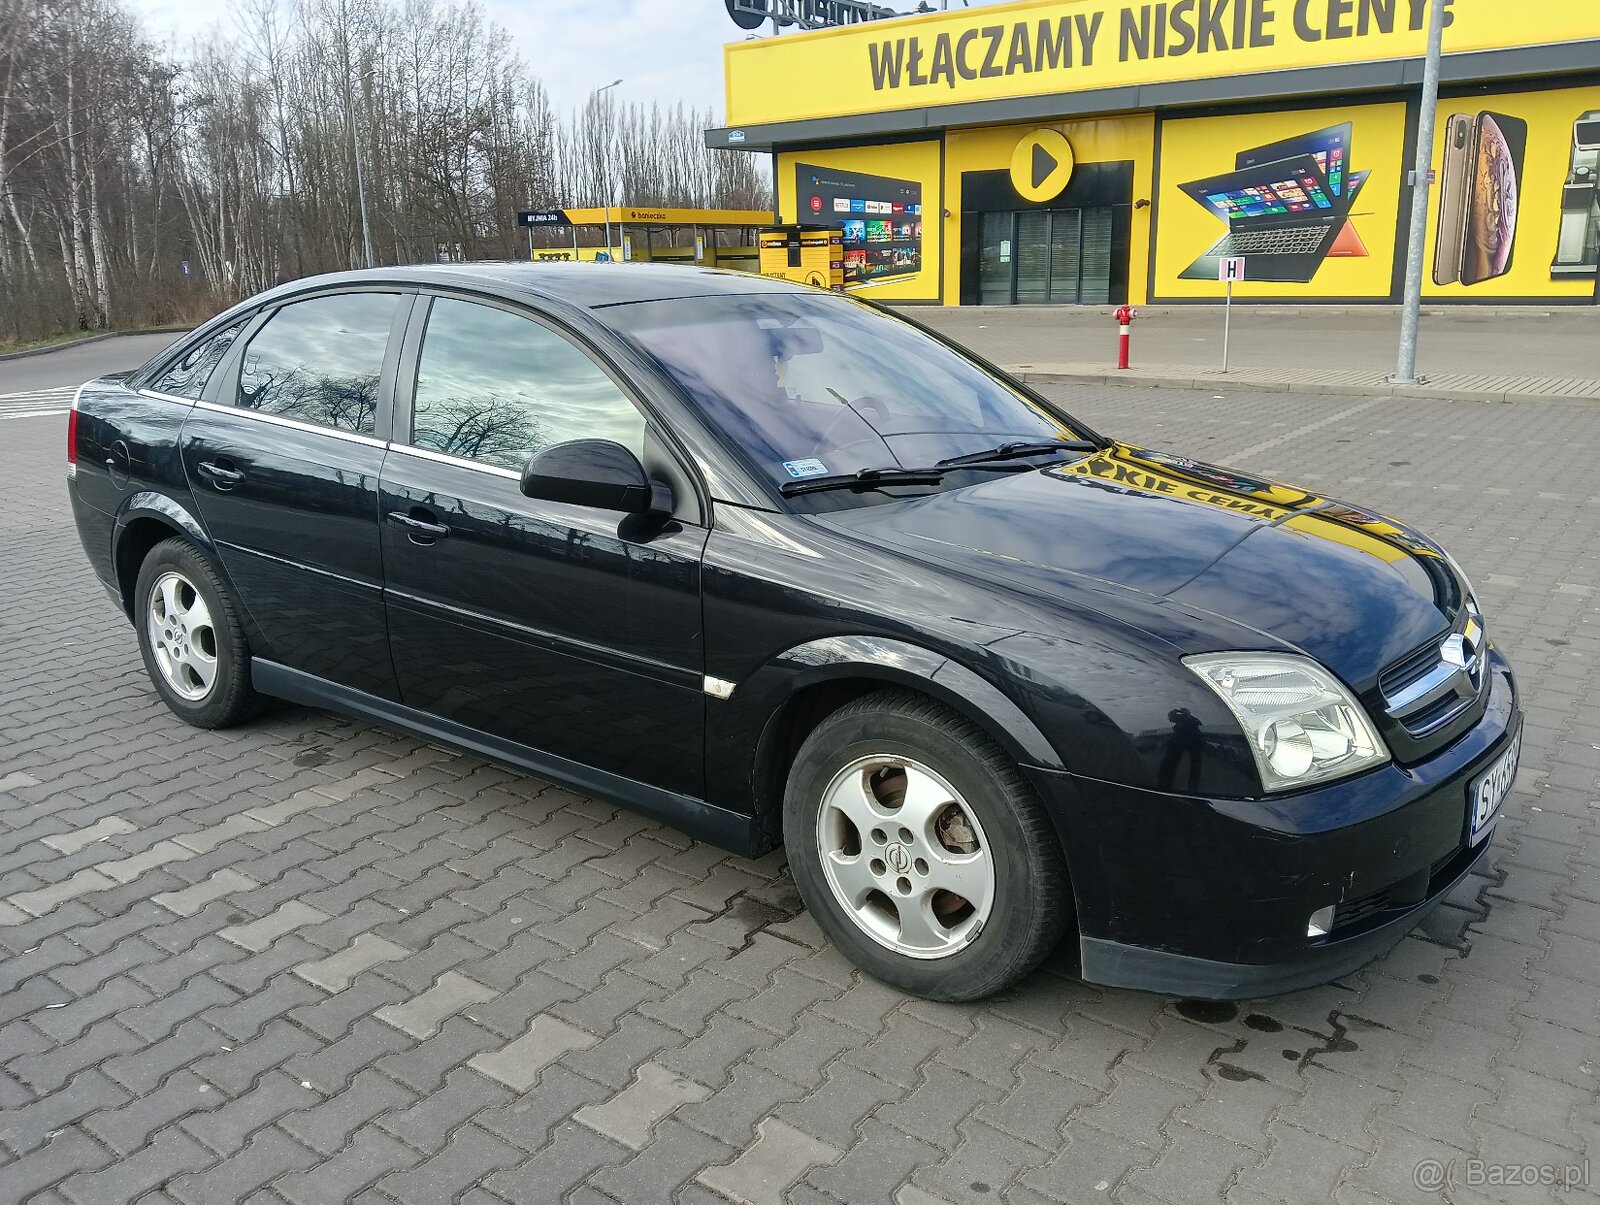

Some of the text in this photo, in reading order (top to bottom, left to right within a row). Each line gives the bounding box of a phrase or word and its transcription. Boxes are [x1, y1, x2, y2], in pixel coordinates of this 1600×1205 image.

[868, 11, 1104, 91] WŁĄCZAMY
[1119, 0, 1275, 62] NISKIE
[1226, 260, 1237, 278] H
